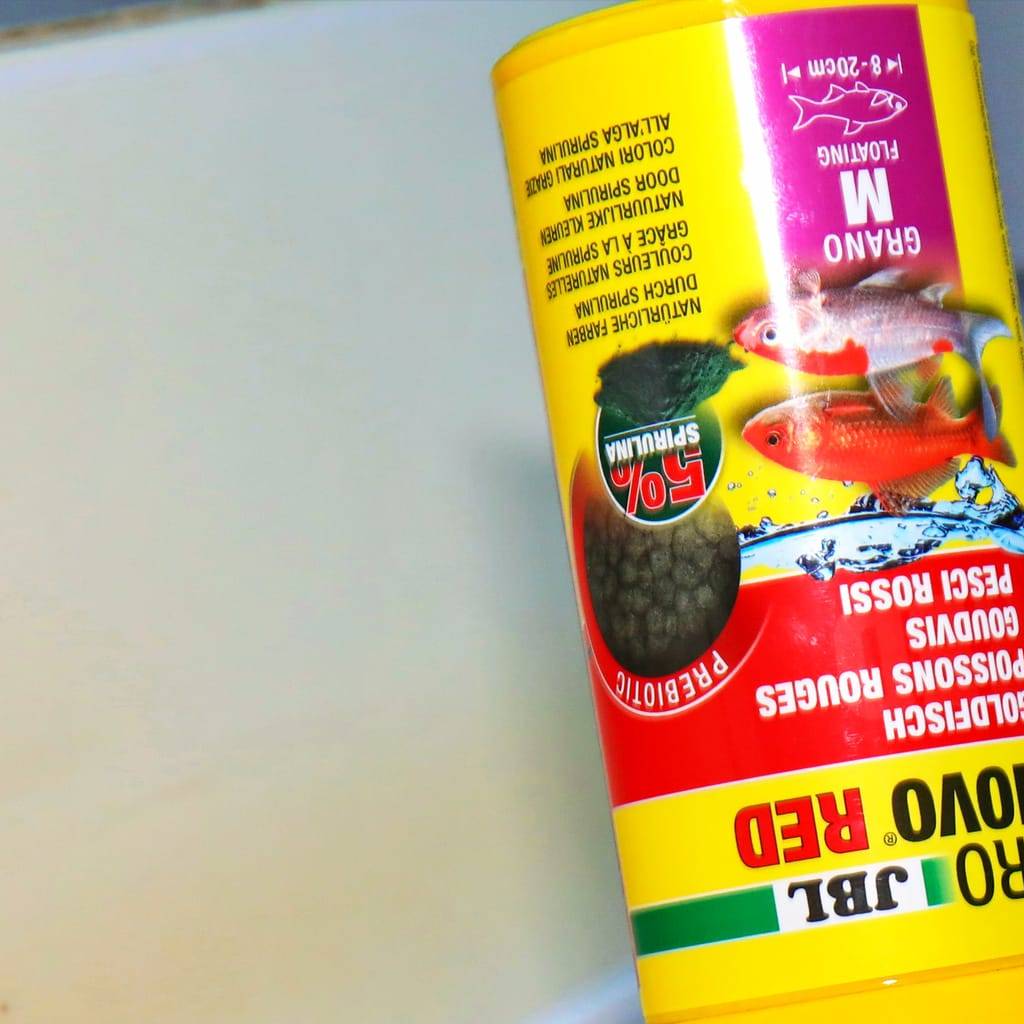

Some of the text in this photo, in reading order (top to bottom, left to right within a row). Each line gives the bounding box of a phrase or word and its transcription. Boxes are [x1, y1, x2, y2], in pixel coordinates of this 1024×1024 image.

[525, 137, 675, 198] COLORI NATURALI GRAZIE
[539, 132, 598, 165] SPIRULINA
[818, 140, 899, 166] FLOATING
[563, 167, 680, 211] DOOR SPIRULINA
[840, 168, 893, 225] M
[540, 190, 684, 245] NATUURLIJKE KLEUREN
[547, 221, 688, 275] GRÂCE À LA SPIRULINE
[823, 226, 921, 263] GRANO
[546, 244, 692, 299] COULEURS NATURELLES
[574, 274, 697, 319] DURCH SPIRULINA
[566, 297, 701, 346] NATÜRLICHE FARBEN
[605, 422, 700, 463] SPIRULINA
[609, 446, 706, 516] 5%
[839, 564, 1013, 615] PESCI ROSSI
[905, 605, 1020, 649] GOUDVIS
[615, 650, 728, 708] PREBIOTIC
[755, 667, 884, 717] ROUGES
[734, 787, 869, 869] RED
[788, 866, 908, 923] JBL
